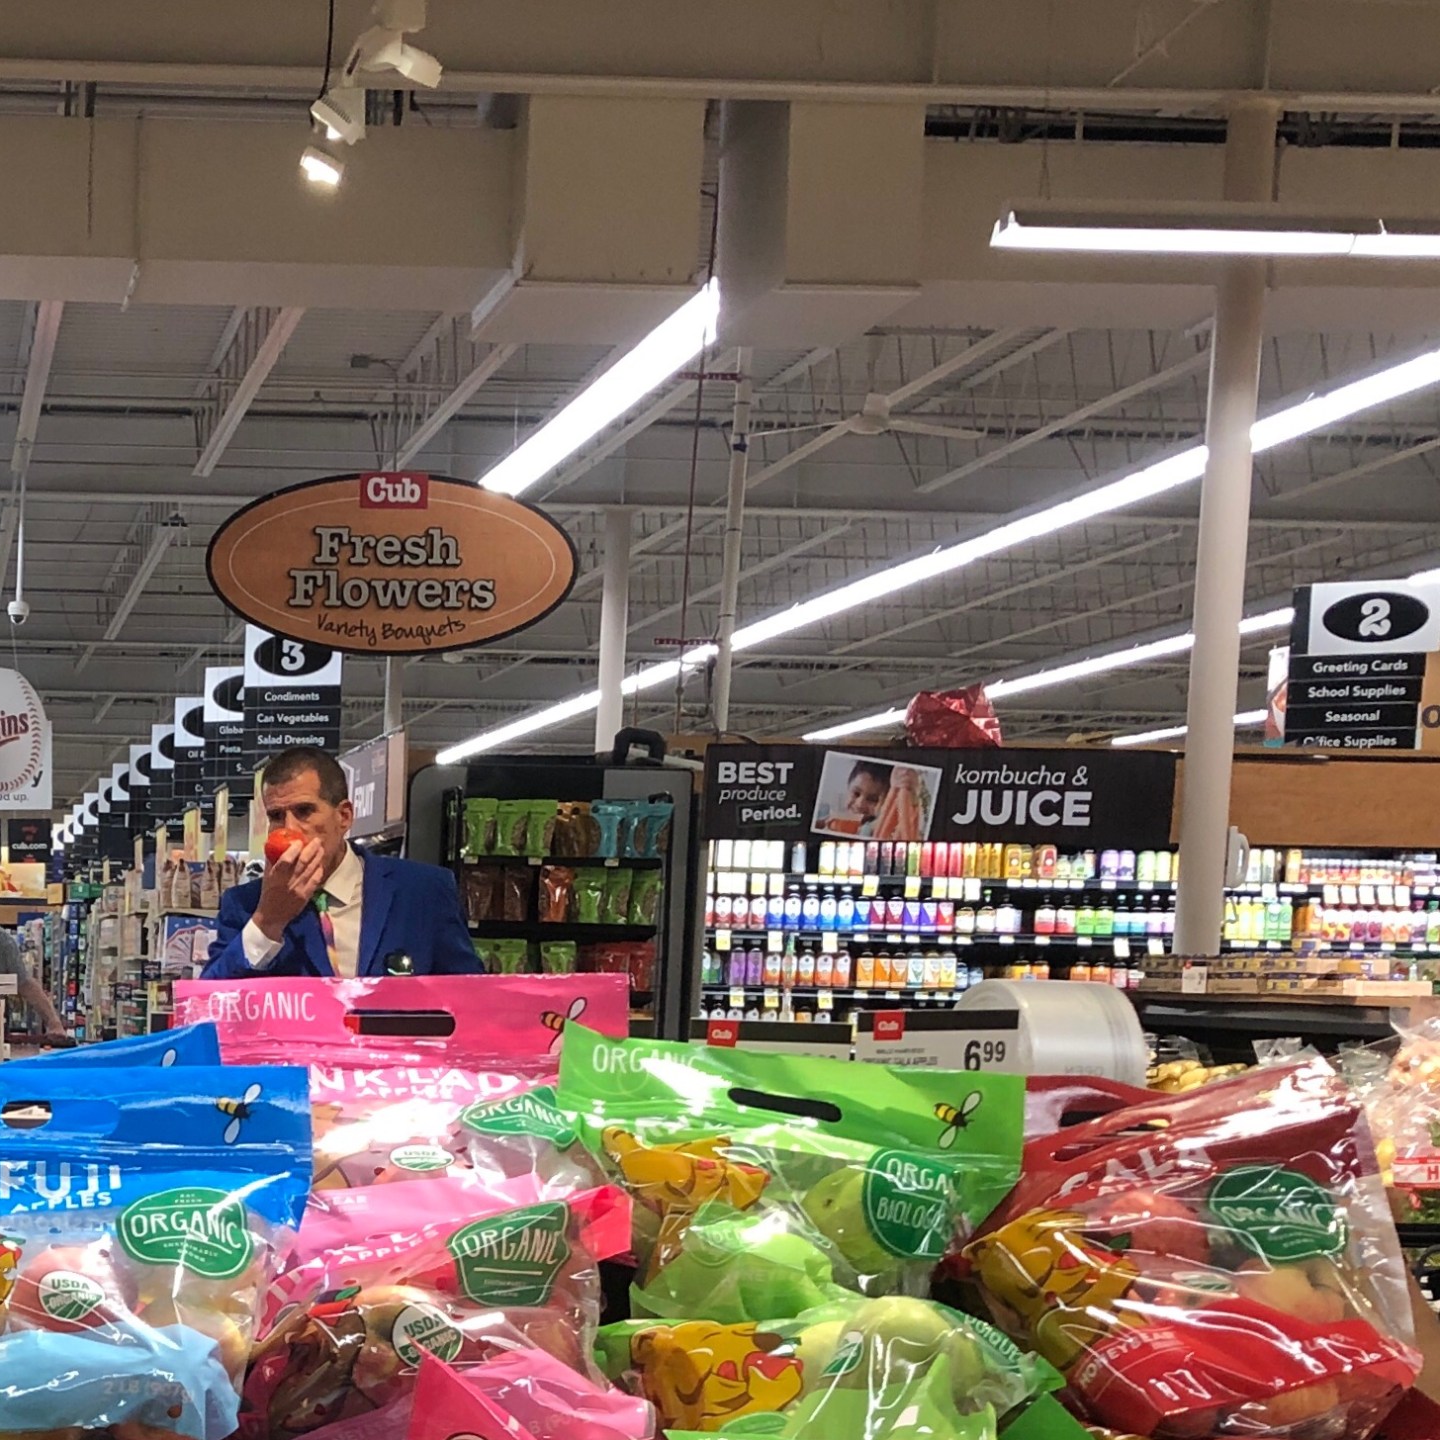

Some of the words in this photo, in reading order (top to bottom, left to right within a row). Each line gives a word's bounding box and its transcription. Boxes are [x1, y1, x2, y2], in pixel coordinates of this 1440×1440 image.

[367, 477, 421, 503] Cub
[313, 526, 461, 566] Fresh
[289, 568, 496, 609] Flowers
[1358, 598, 1392, 637] 2
[317, 612, 377, 645] Variety
[382, 618, 466, 645] Bouquets
[280, 639, 305, 671] 3
[1312, 661, 1368, 674] Greeting
[1371, 659, 1408, 671] Cards
[264, 691, 320, 702] Condiments
[1308, 686, 1350, 698] School
[1352, 685, 1406, 699] Supplies
[257, 713, 275, 723] Can
[277, 712, 329, 725] Vegetables
[1325, 709, 1381, 723] Seasonal
[219, 726, 244, 735] Globa
[257, 735, 281, 745] Salad
[284, 735, 325, 746] Dressing
[1344, 735, 1397, 748] Supplies
[717, 762, 794, 784] BEST
[955, 763, 1066, 786] kombucha
[1071, 765, 1089, 786] &
[13, 793, 30, 804] up.
[719, 786, 786, 804] produce
[741, 804, 802, 823] Period.
[952, 791, 1093, 827] JUICE
[11, 841, 48, 850] cub.com
[207, 991, 317, 1023] ORGANIC
[130, 1209, 242, 1249] ORGANIC
[461, 1216, 560, 1266] ORGANIC
[51, 1278, 91, 1293] USDA
